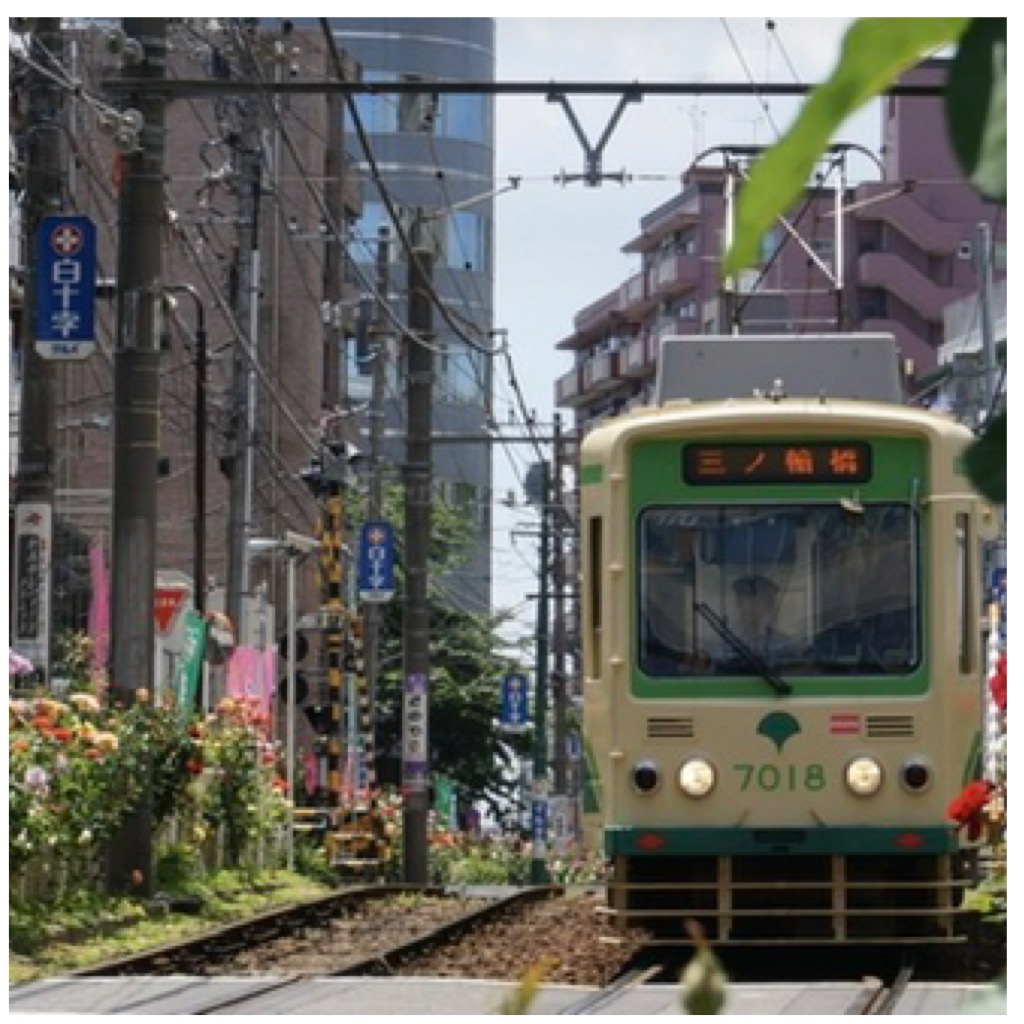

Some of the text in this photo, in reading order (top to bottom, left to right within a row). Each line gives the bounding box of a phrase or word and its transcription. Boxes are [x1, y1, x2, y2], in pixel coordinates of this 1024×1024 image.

[50, 257, 82, 339] 白十字
[733, 763, 826, 792] 7018
